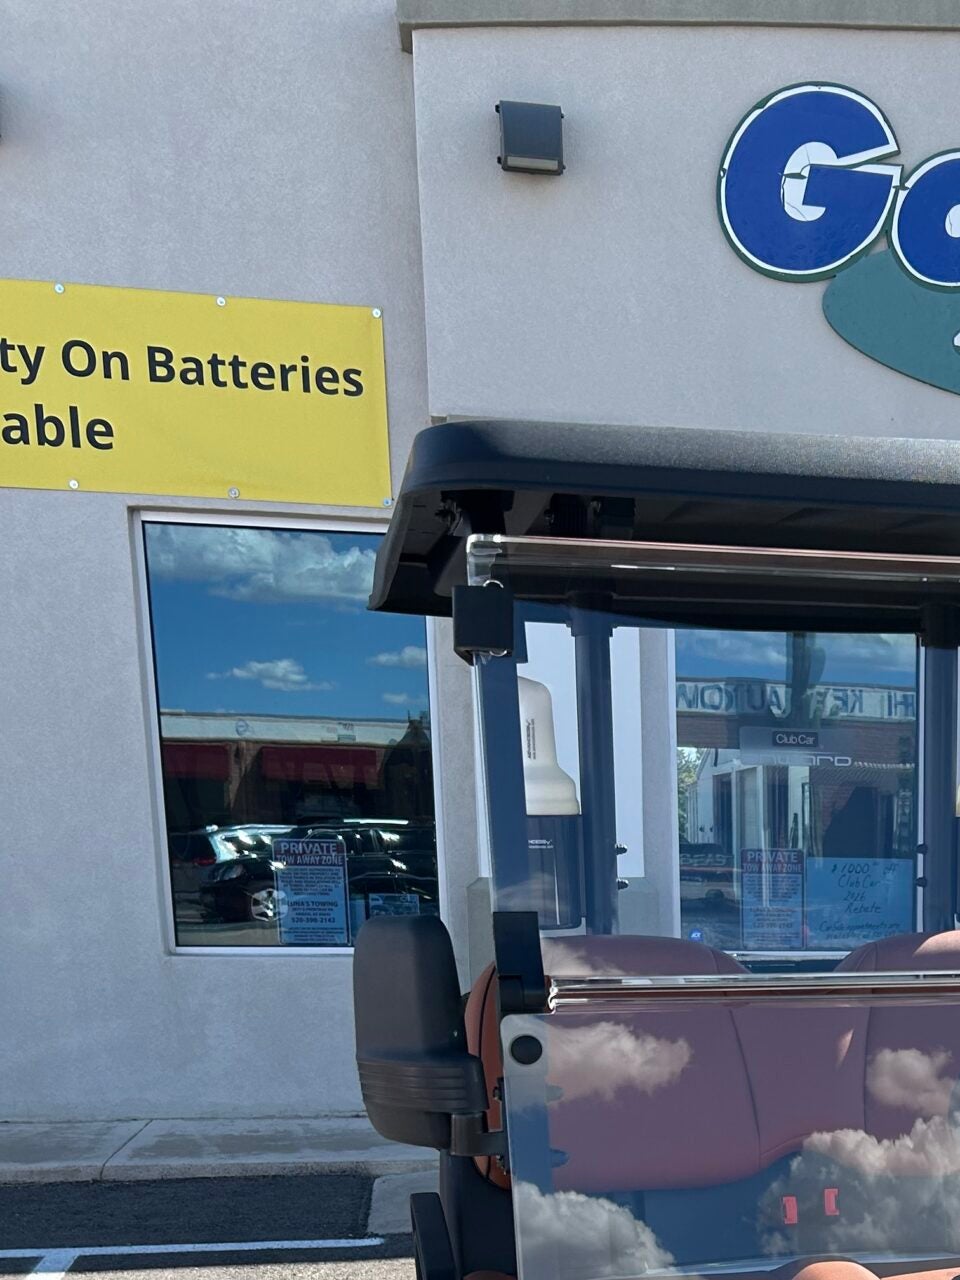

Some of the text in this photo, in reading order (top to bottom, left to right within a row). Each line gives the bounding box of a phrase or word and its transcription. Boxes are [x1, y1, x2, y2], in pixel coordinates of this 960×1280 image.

[0, 337, 365, 397] ty On Batteries
[1, 403, 115, 451] able
[775, 733, 816, 745] Club Car
[280, 842, 337, 855] PRIVATE
[276, 855, 343, 865] TOW AWAY ZONE
[747, 851, 799, 862] PRIVATE
[783, 863, 803, 873] ZONE
